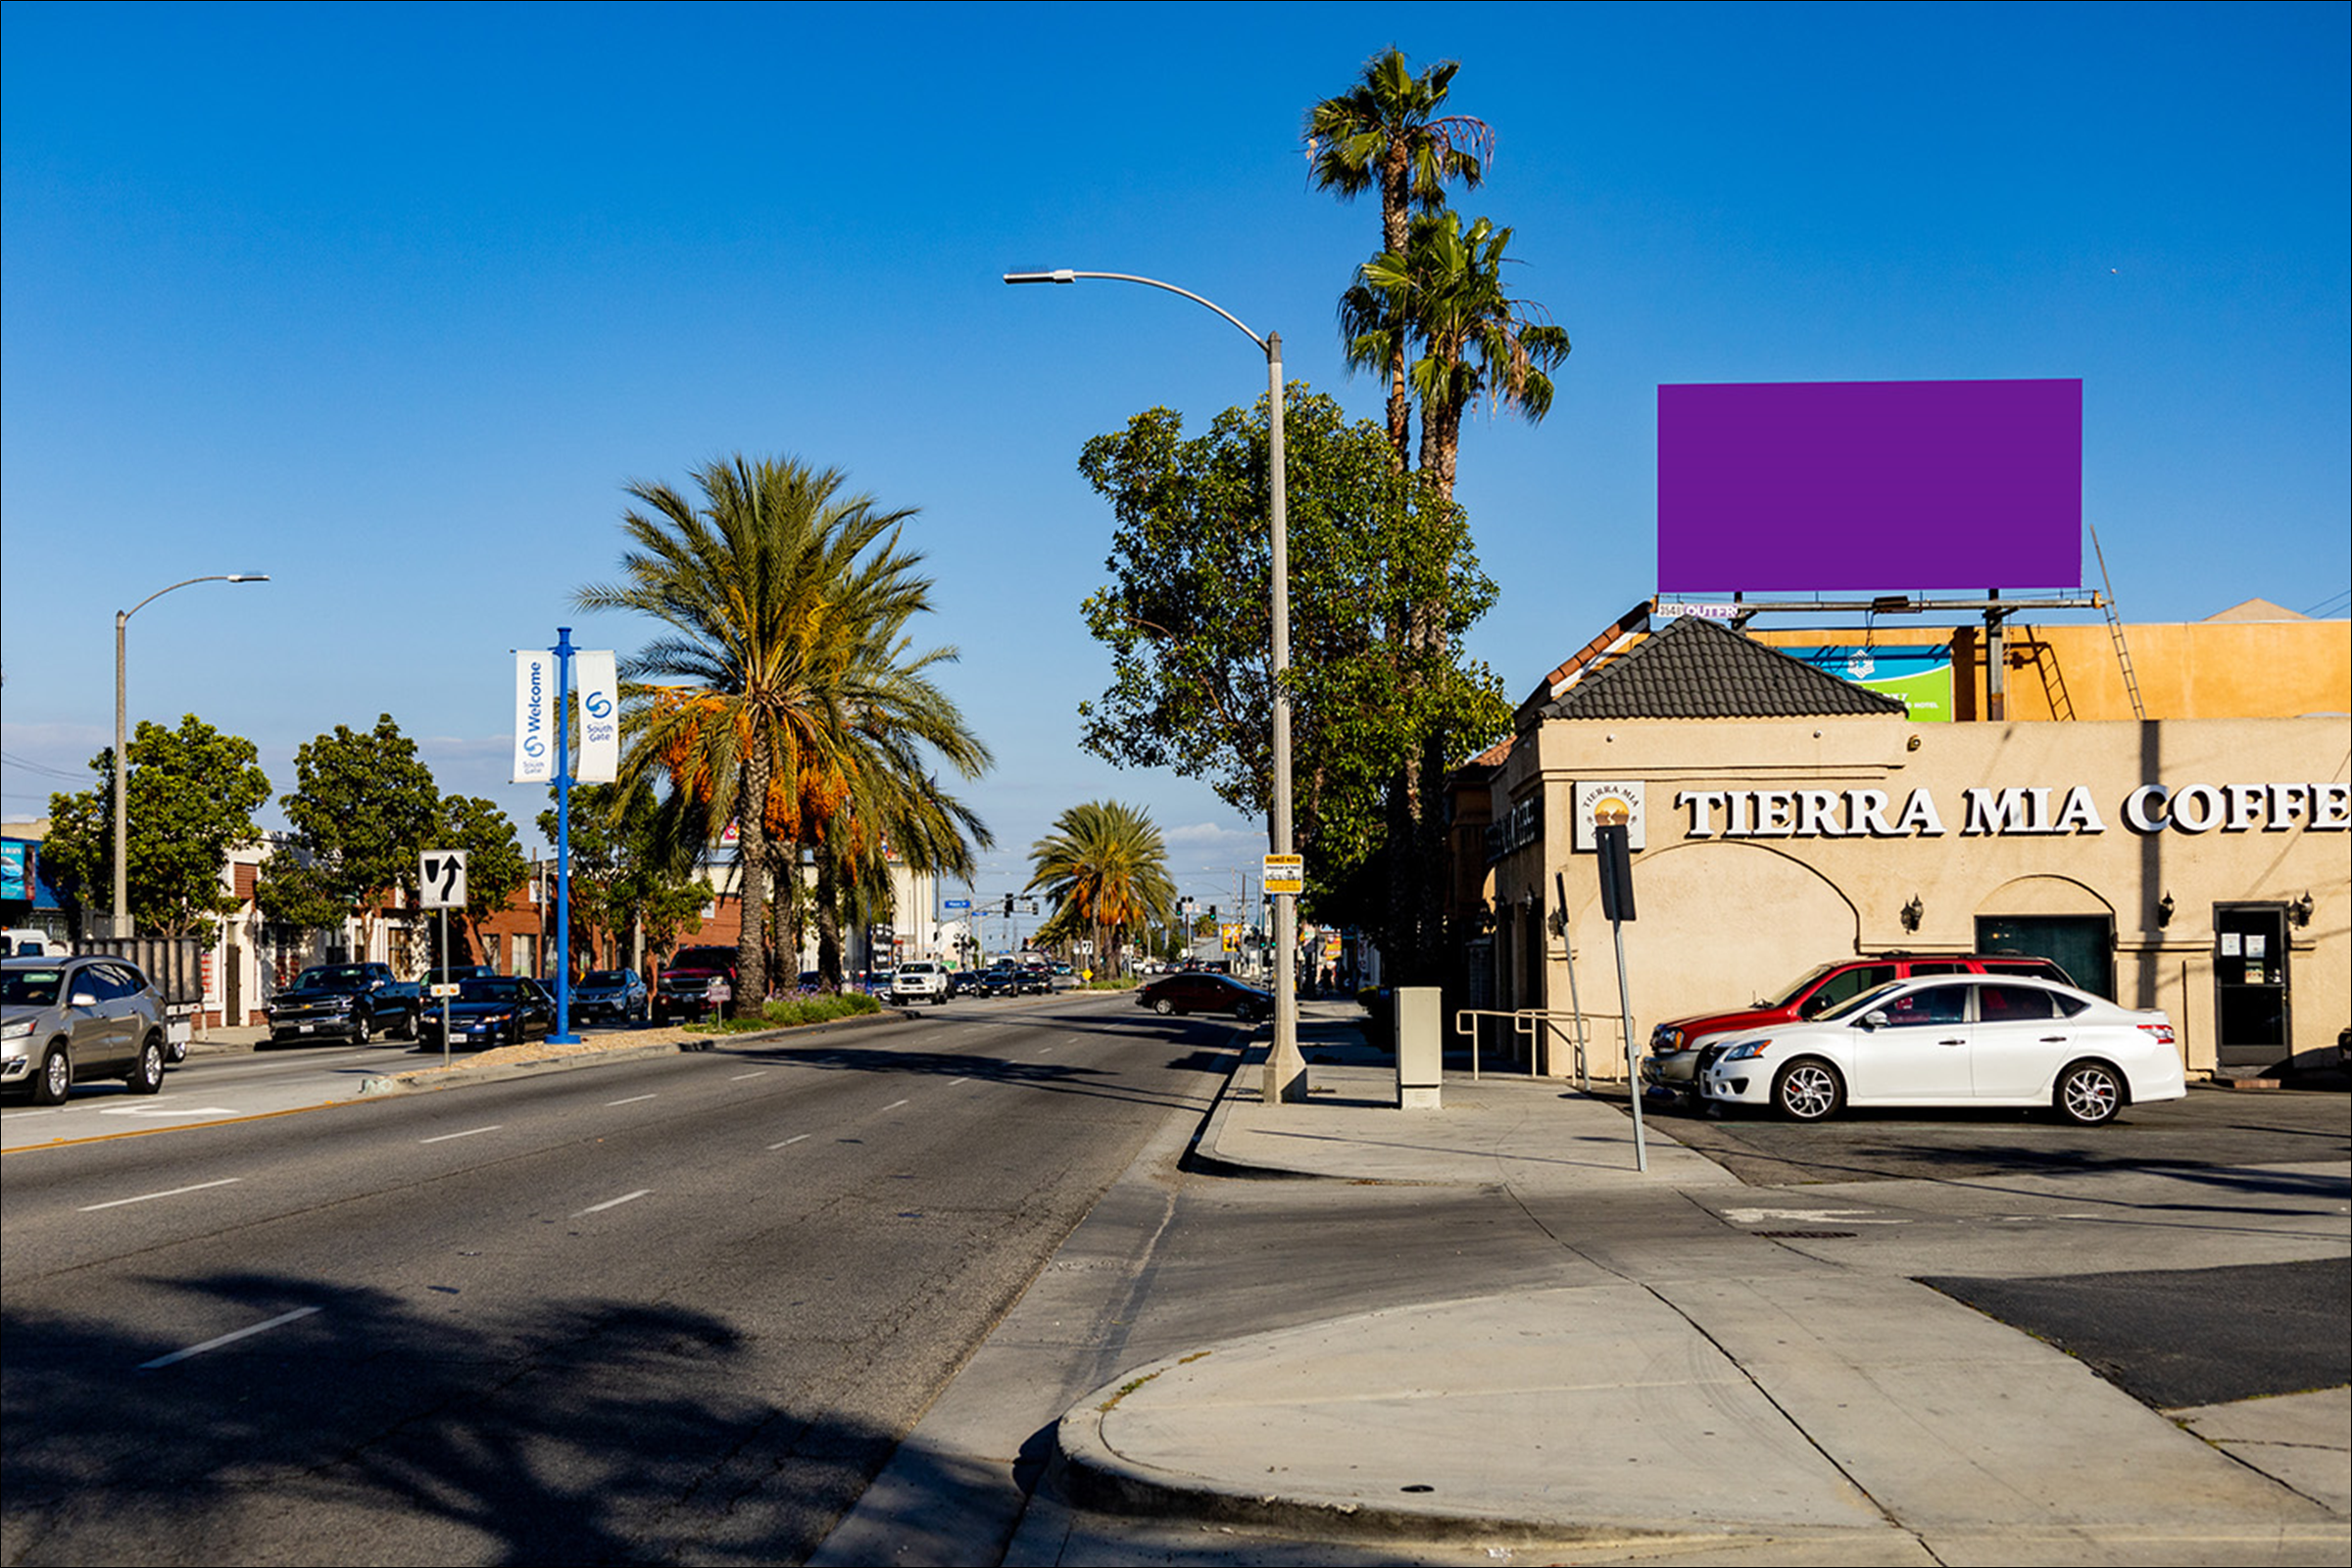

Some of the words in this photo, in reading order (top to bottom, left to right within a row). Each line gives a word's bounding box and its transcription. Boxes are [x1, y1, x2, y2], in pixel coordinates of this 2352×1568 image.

[528, 662, 542, 733] Welcome
[587, 723, 613, 733] South
[589, 734, 611, 743] Gate
[1583, 786, 1619, 808] TIERRA
[1622, 789, 1640, 808] MIA
[1676, 788, 1947, 835] TIERRA
[1965, 785, 2108, 834] MIA
